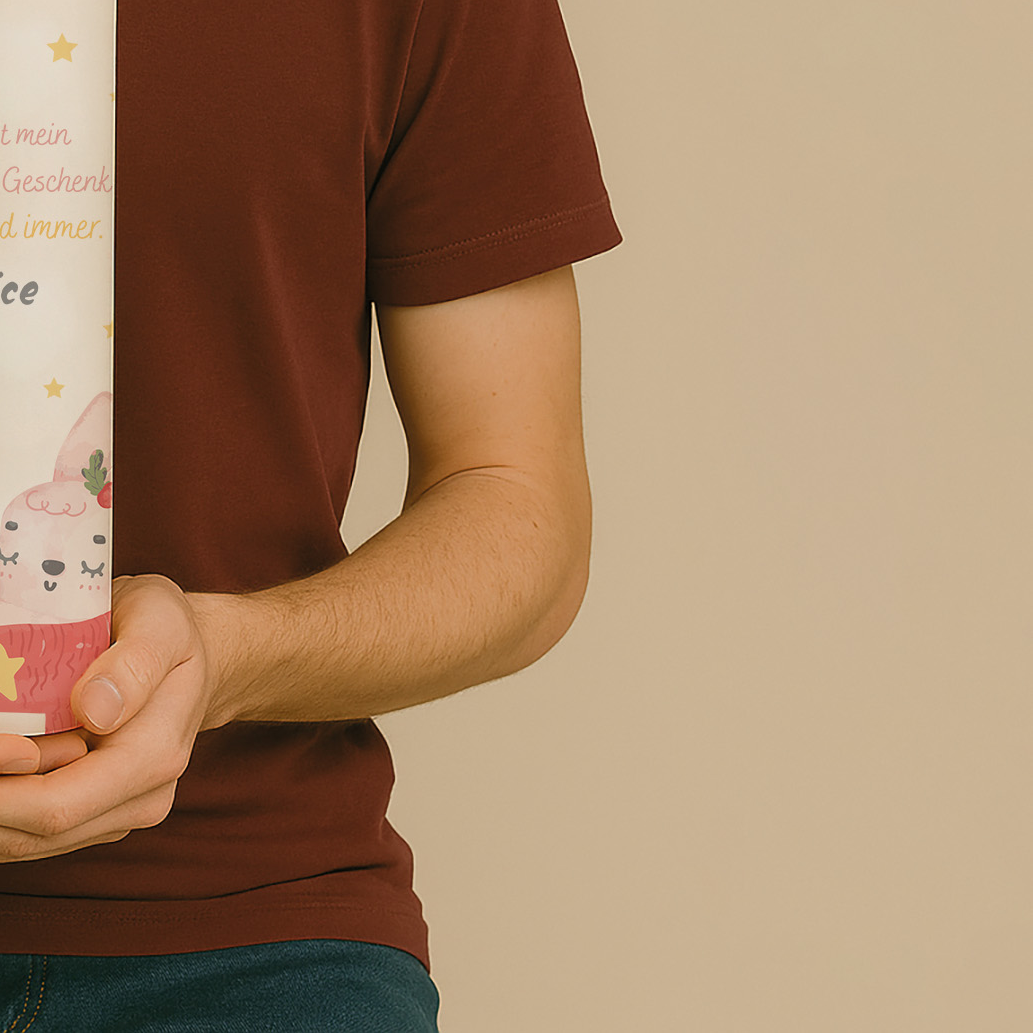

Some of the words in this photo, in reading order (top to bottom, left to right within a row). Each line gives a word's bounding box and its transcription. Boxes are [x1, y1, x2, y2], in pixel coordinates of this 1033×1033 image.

[15, 122, 72, 146] mein
[2, 165, 113, 194] Geschenk
[23, 213, 103, 240] immer.
